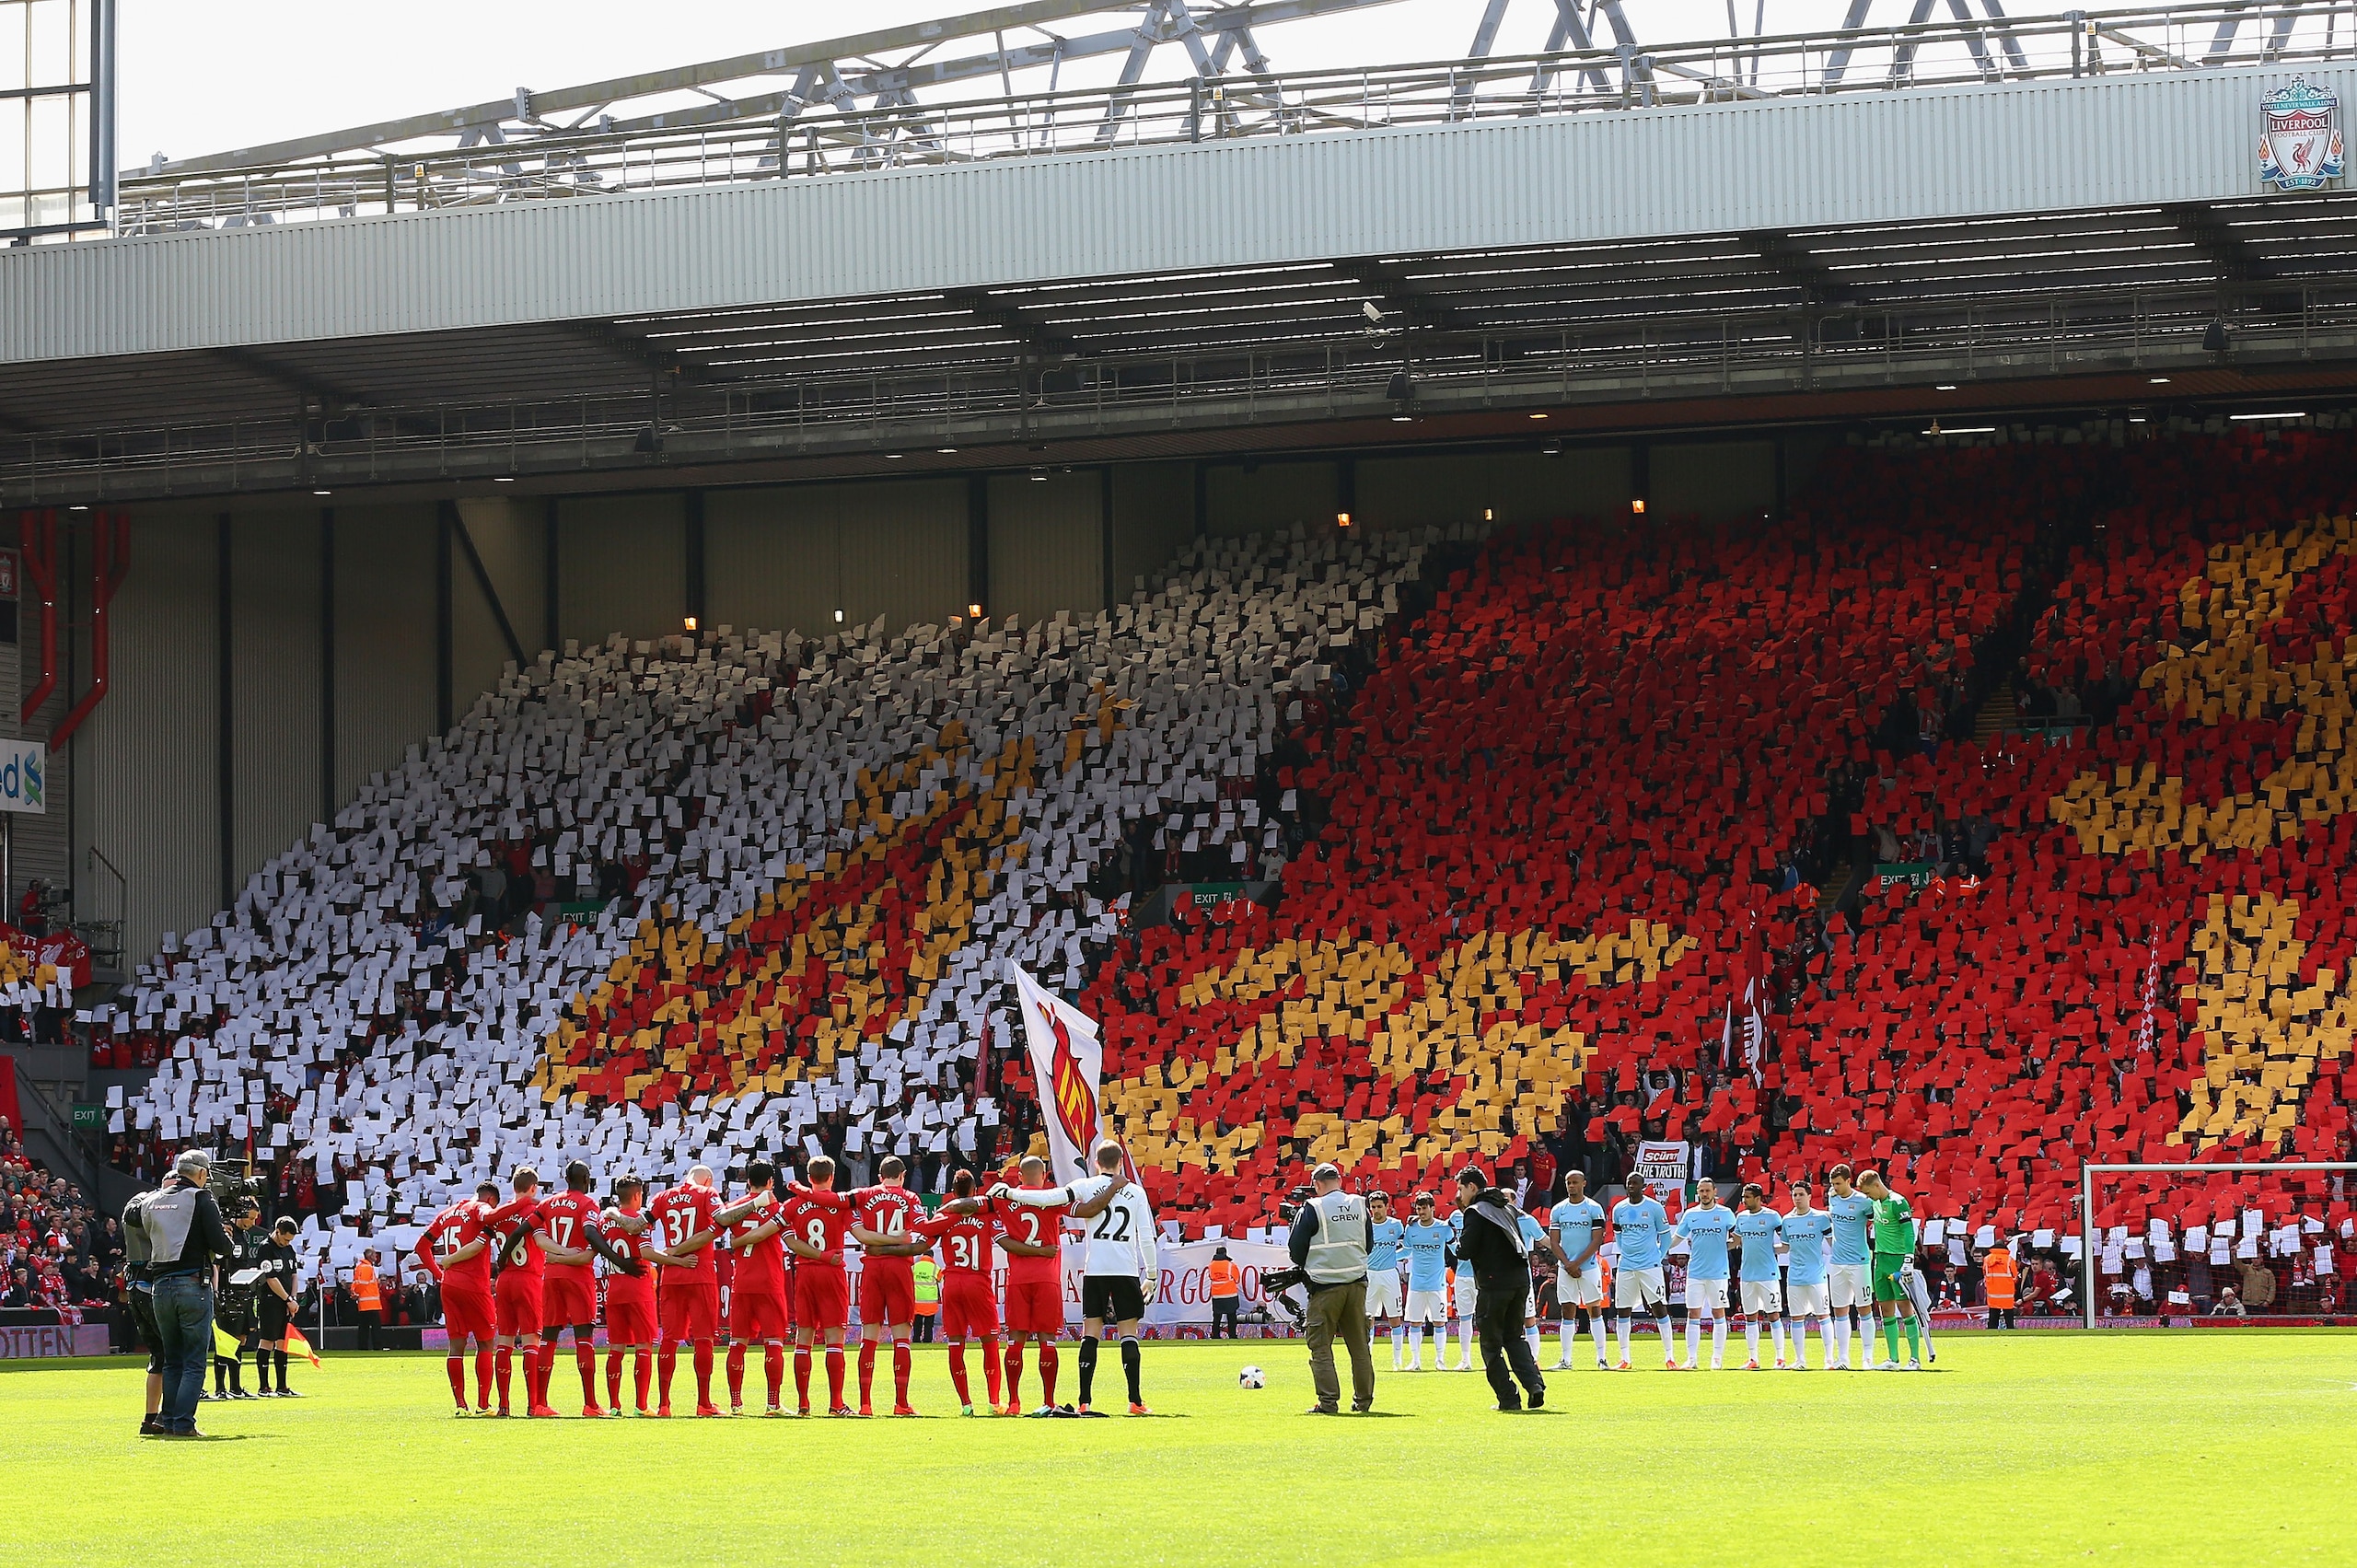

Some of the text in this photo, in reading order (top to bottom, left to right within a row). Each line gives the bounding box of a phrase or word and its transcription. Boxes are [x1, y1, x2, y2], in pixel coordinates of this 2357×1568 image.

[2271, 118, 2328, 131] LIVERPOOL
[1880, 875, 1905, 886] EXIT
[1194, 893, 1218, 904] EXIT
[74, 1110, 95, 1121] EXIT
[1638, 1164, 1685, 1179] THE TRUTH
[550, 1199, 577, 1210] SAKHO
[797, 1201, 838, 1215] GERD
[865, 1193, 910, 1214] HENDERSON
[666, 1206, 697, 1247] 37
[876, 1208, 905, 1237] 14
[1093, 1205, 1131, 1242] 22
[1331, 1214, 1359, 1223] CREW
[443, 1225, 462, 1256] 15
[550, 1216, 575, 1248] 17
[741, 1220, 760, 1258] 7
[807, 1218, 827, 1252] 8
[1020, 1212, 1043, 1248] 2
[950, 1234, 980, 1272] 31
[1862, 1285, 1871, 1298] 10
